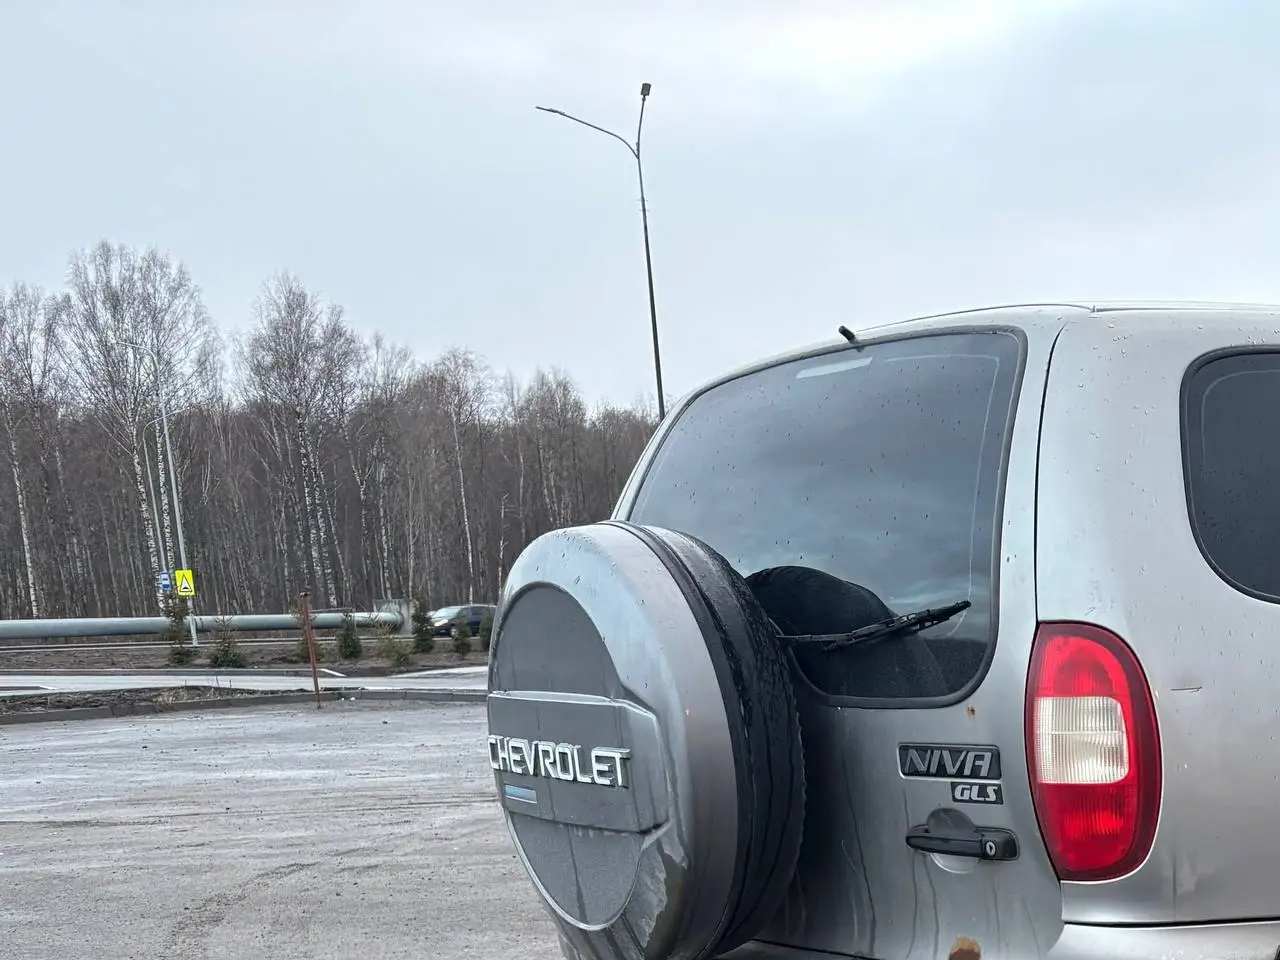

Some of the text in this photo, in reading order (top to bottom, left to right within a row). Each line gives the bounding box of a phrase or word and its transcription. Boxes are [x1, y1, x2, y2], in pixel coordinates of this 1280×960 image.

[488, 735, 630, 788] CHEVROLET
[904, 748, 993, 777] NIVA
[955, 784, 998, 801] GLS
